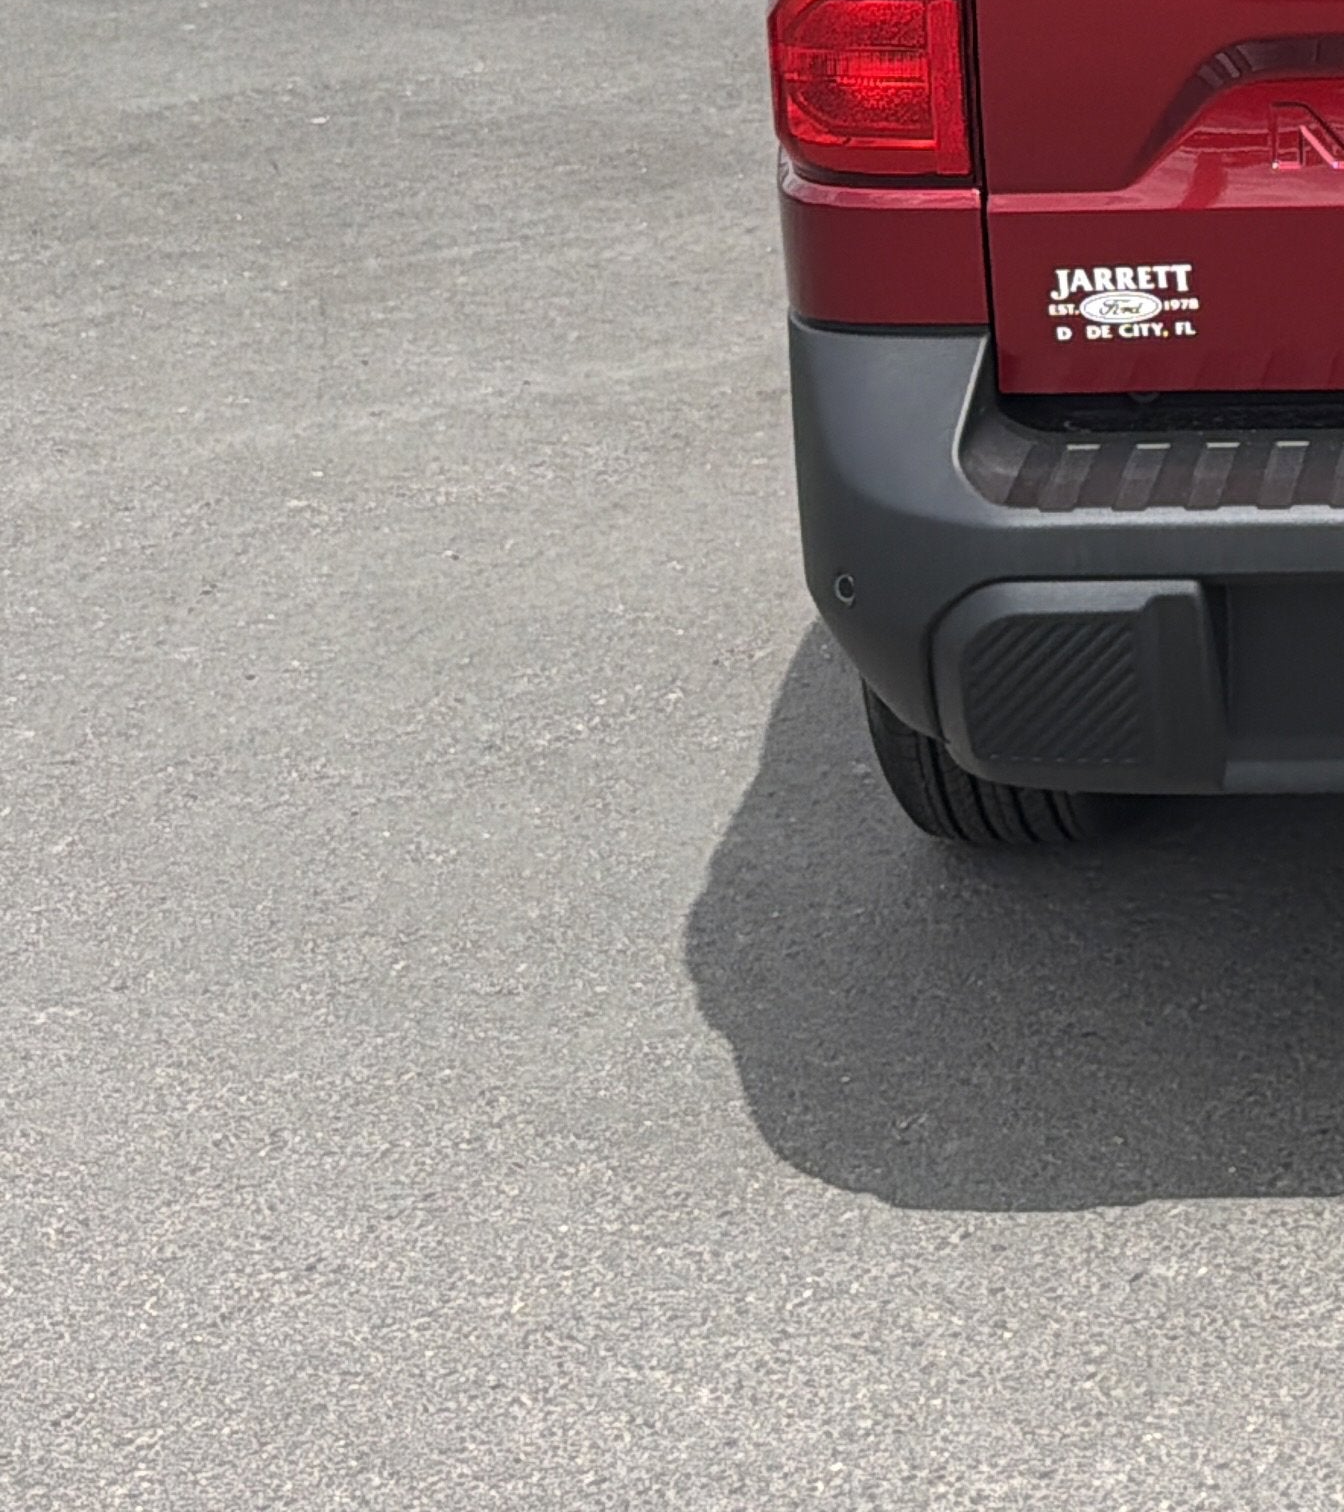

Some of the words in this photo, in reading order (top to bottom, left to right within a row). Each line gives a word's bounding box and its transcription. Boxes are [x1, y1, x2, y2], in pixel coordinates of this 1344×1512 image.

[1050, 264, 1192, 300] JARRETT
[1048, 303, 1080, 316] EST.
[1056, 324, 1113, 341] DDE
[1174, 321, 1197, 336] FL
